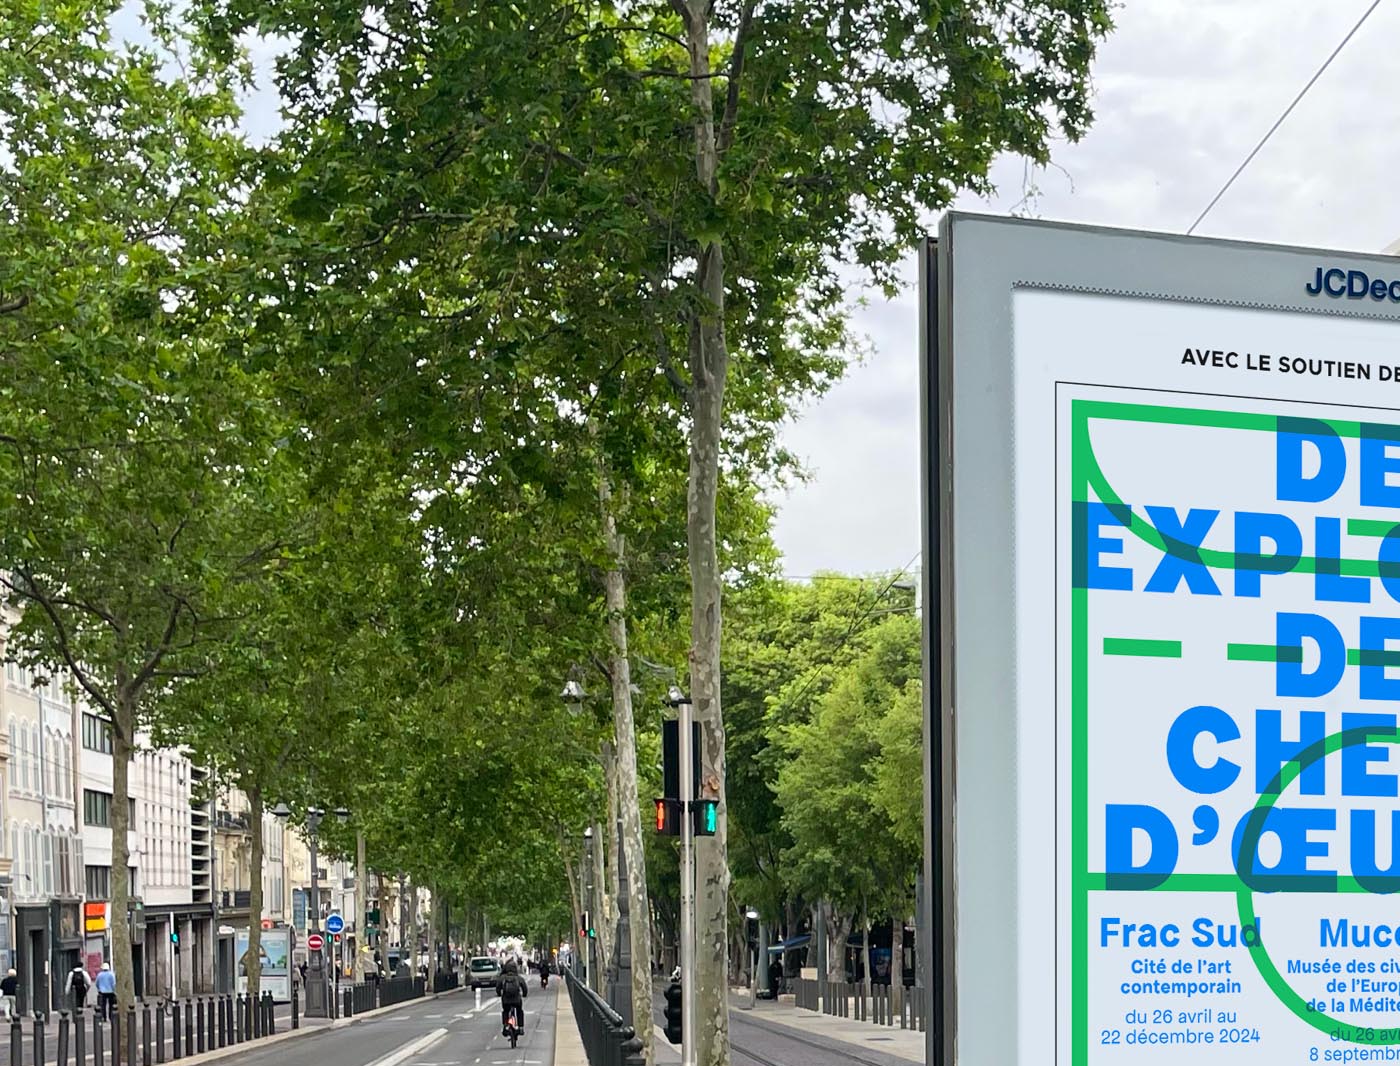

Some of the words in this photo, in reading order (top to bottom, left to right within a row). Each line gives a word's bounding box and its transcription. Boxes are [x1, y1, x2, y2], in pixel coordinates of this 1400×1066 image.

[1181, 348, 1238, 368] AVEC
[1247, 354, 1270, 371] LE
[1279, 356, 1370, 380] SOUTIEN
[1101, 918, 1179, 947] Frac
[1192, 917, 1261, 947] Sud
[1132, 959, 1166, 973] Cité
[1172, 960, 1192, 973] de
[1198, 960, 1231, 973] l'art
[1288, 959, 1341, 973] Musée
[1347, 960, 1375, 973] des
[1121, 979, 1240, 997] contemporain
[1327, 979, 1346, 992] de
[1306, 998, 1325, 1012] de
[1331, 998, 1344, 1012] la
[1126, 1009, 1146, 1024] du
[1153, 1010, 1172, 1023] 26
[1179, 1009, 1211, 1023] avril
[1218, 1012, 1236, 1023] au
[1102, 1030, 1120, 1044] 22
[1126, 1029, 1214, 1044] décembre
[1220, 1029, 1260, 1043] 2024
[1330, 1028, 1350, 1042] du
[1355, 1028, 1375, 1042] 26
[1310, 1047, 1318, 1061] 8
